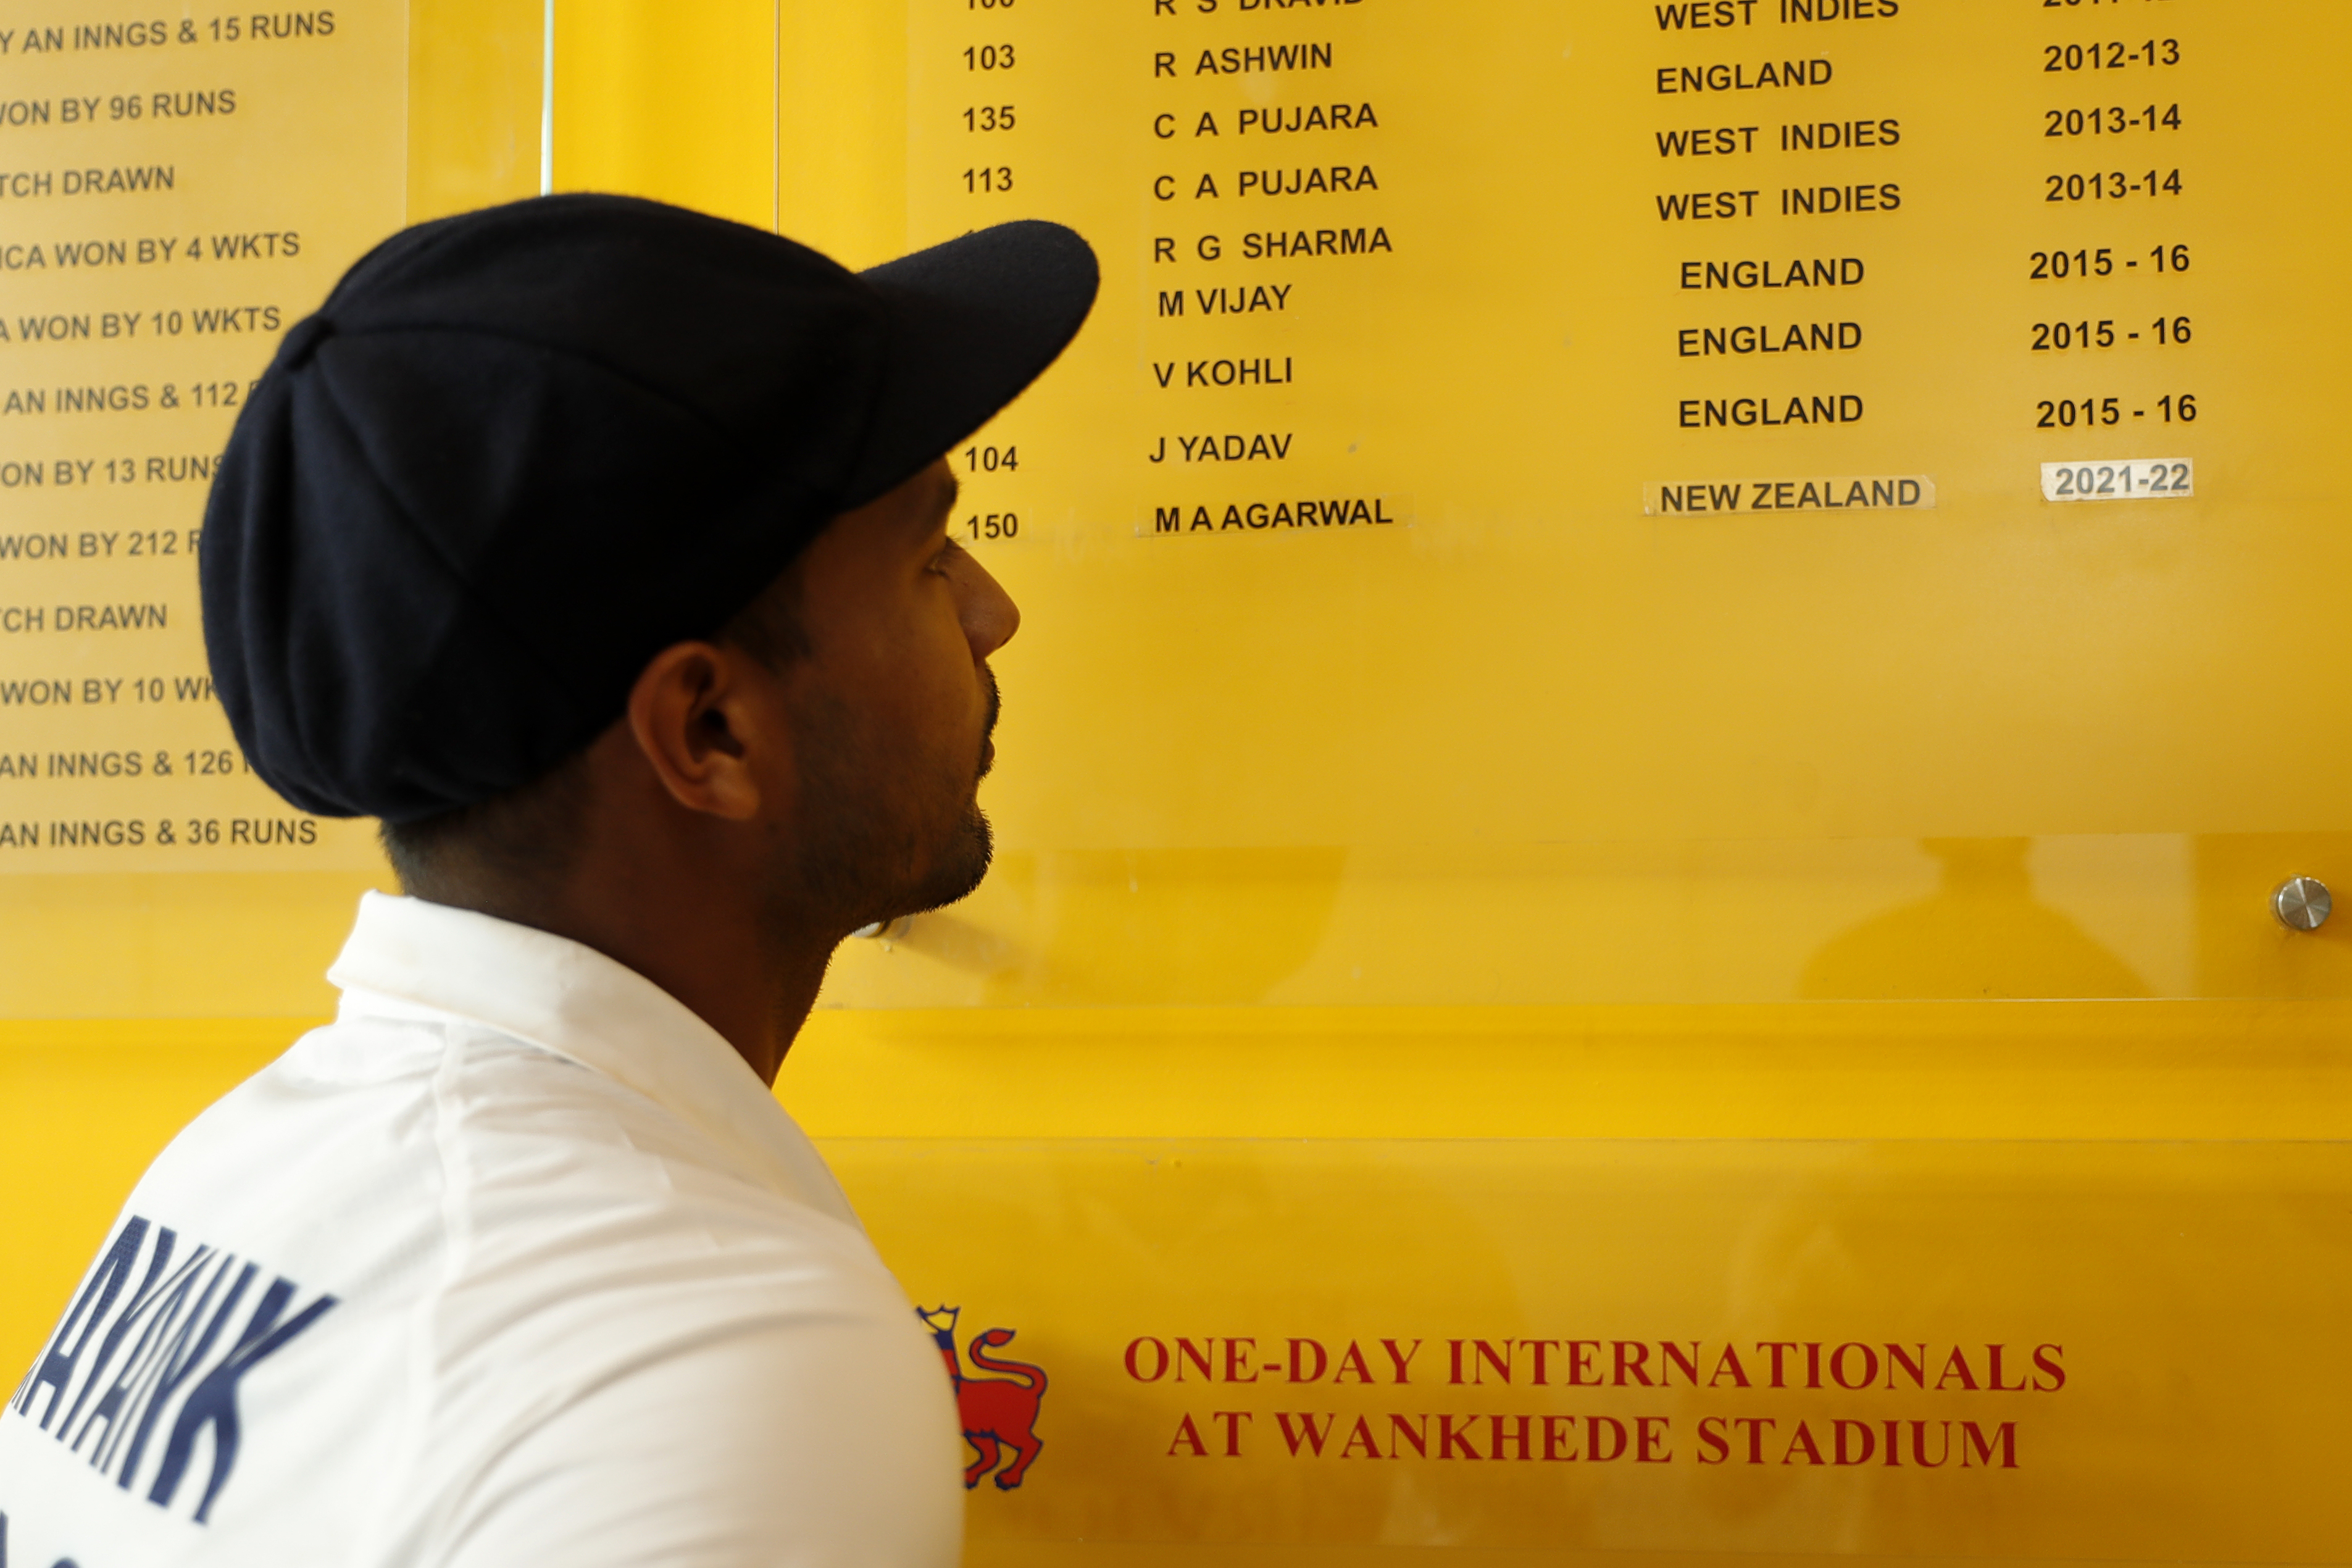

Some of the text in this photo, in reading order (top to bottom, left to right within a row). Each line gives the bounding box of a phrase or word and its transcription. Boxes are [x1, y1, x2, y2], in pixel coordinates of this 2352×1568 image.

[23, 28, 63, 52] AN
[74, 21, 167, 49] INNGS
[178, 19, 197, 44] &
[210, 17, 240, 41] 15
[251, 10, 335, 38] RUNS
[1655, 0, 1899, 30] WEST INDIES
[964, 44, 1015, 70] 103
[1155, 43, 1332, 77] R ASHWIN
[2045, 38, 2180, 72] 2012-13
[1657, 59, 1832, 94] ENGLAND
[61, 97, 100, 123] BY
[109, 94, 142, 120] 96
[152, 90, 236, 117] RUNS
[964, 106, 1015, 131] 135
[1154, 102, 1378, 139] C A PUJARA
[2045, 103, 2182, 136] 2013-14
[1656, 119, 1900, 157] WEST INDIES
[63, 166, 174, 194] DRAWN
[964, 167, 1013, 193] 113
[1154, 165, 1378, 201] C A PUJARA
[2046, 169, 2182, 201] 2013-14
[1656, 183, 1901, 221] WEST INDIES
[55, 241, 126, 267] WON
[137, 238, 177, 264] BY
[186, 238, 201, 260] 4
[212, 232, 299, 259] WKTS
[1155, 227, 1392, 262] R G SHARMA
[1681, 258, 1864, 289] ENGLAND
[2030, 248, 2112, 279] 2015
[2153, 244, 2190, 272] 16
[1159, 284, 1291, 317] M VIJAY
[19, 315, 90, 341] WON
[101, 313, 141, 338] BY
[152, 311, 183, 335] 10
[193, 306, 280, 333] WKTS
[1679, 322, 1862, 357] ENGLAND
[2032, 320, 2114, 351] 2015
[2153, 316, 2191, 344] 16
[1153, 357, 1291, 388] V KOHLI
[4, 390, 45, 414] AN
[56, 385, 149, 411] INNGS
[160, 384, 179, 409] &
[192, 382, 238, 406] 112
[1680, 394, 1863, 427] ENGLAND
[2037, 398, 2119, 428] 2015
[2158, 394, 2196, 422] 16
[965, 446, 1018, 472] 104
[1149, 433, 1292, 463] J YADAV
[54, 460, 94, 485] BY
[105, 458, 136, 483] 13
[2056, 463, 2190, 495] 2021-22
[1661, 479, 1920, 512] NEW ZEALAND
[967, 513, 1018, 540] 150
[1156, 499, 1393, 532] M A AGARWAL
[78, 533, 119, 557] BY
[128, 530, 177, 556] 212
[0, 604, 167, 633] CH DRAWN
[0, 680, 71, 705] WON
[83, 679, 122, 704] BY
[134, 677, 165, 703] 10
[0, 754, 37, 777] AN
[49, 752, 142, 777] INNGS
[153, 751, 172, 776] &
[185, 750, 233, 775] 126
[0, 819, 316, 846] AN INNGS & 36 RUNS
[11, 1214, 340, 1525] AYANK
[1124, 1337, 2066, 1393] ONE-DAY INTERNATIONALS
[1166, 1411, 2019, 1469] AT WANKHEDE STADIUM
